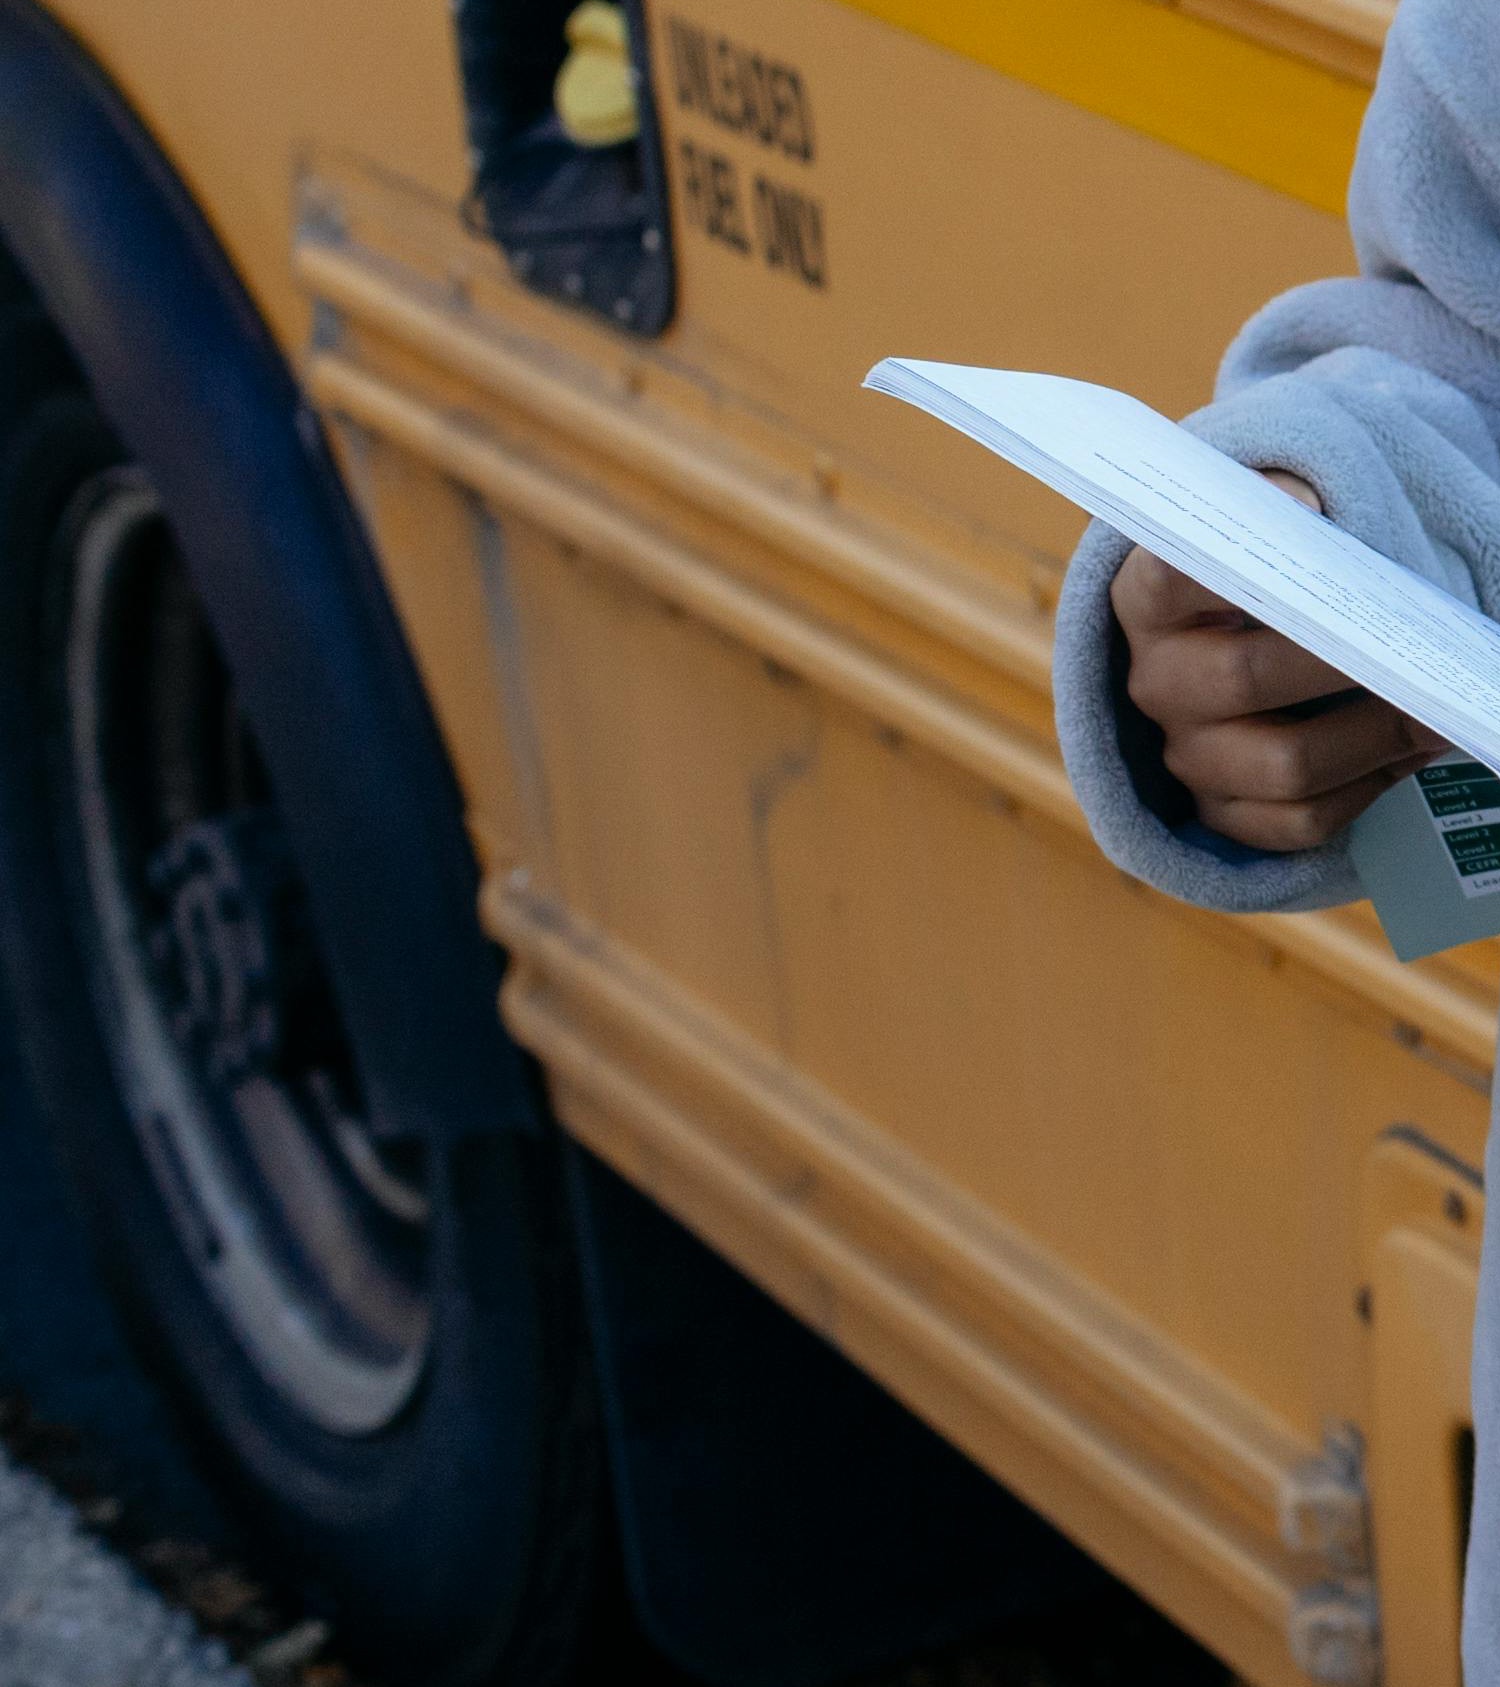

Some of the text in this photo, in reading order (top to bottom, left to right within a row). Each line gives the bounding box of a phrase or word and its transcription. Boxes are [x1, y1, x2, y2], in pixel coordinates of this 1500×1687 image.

[1428, 787, 1461, 799] Level
[1435, 801, 1467, 813] Level
[1442, 815, 1474, 828] Level
[1448, 830, 1480, 843] Level
[1455, 845, 1487, 857] Level
